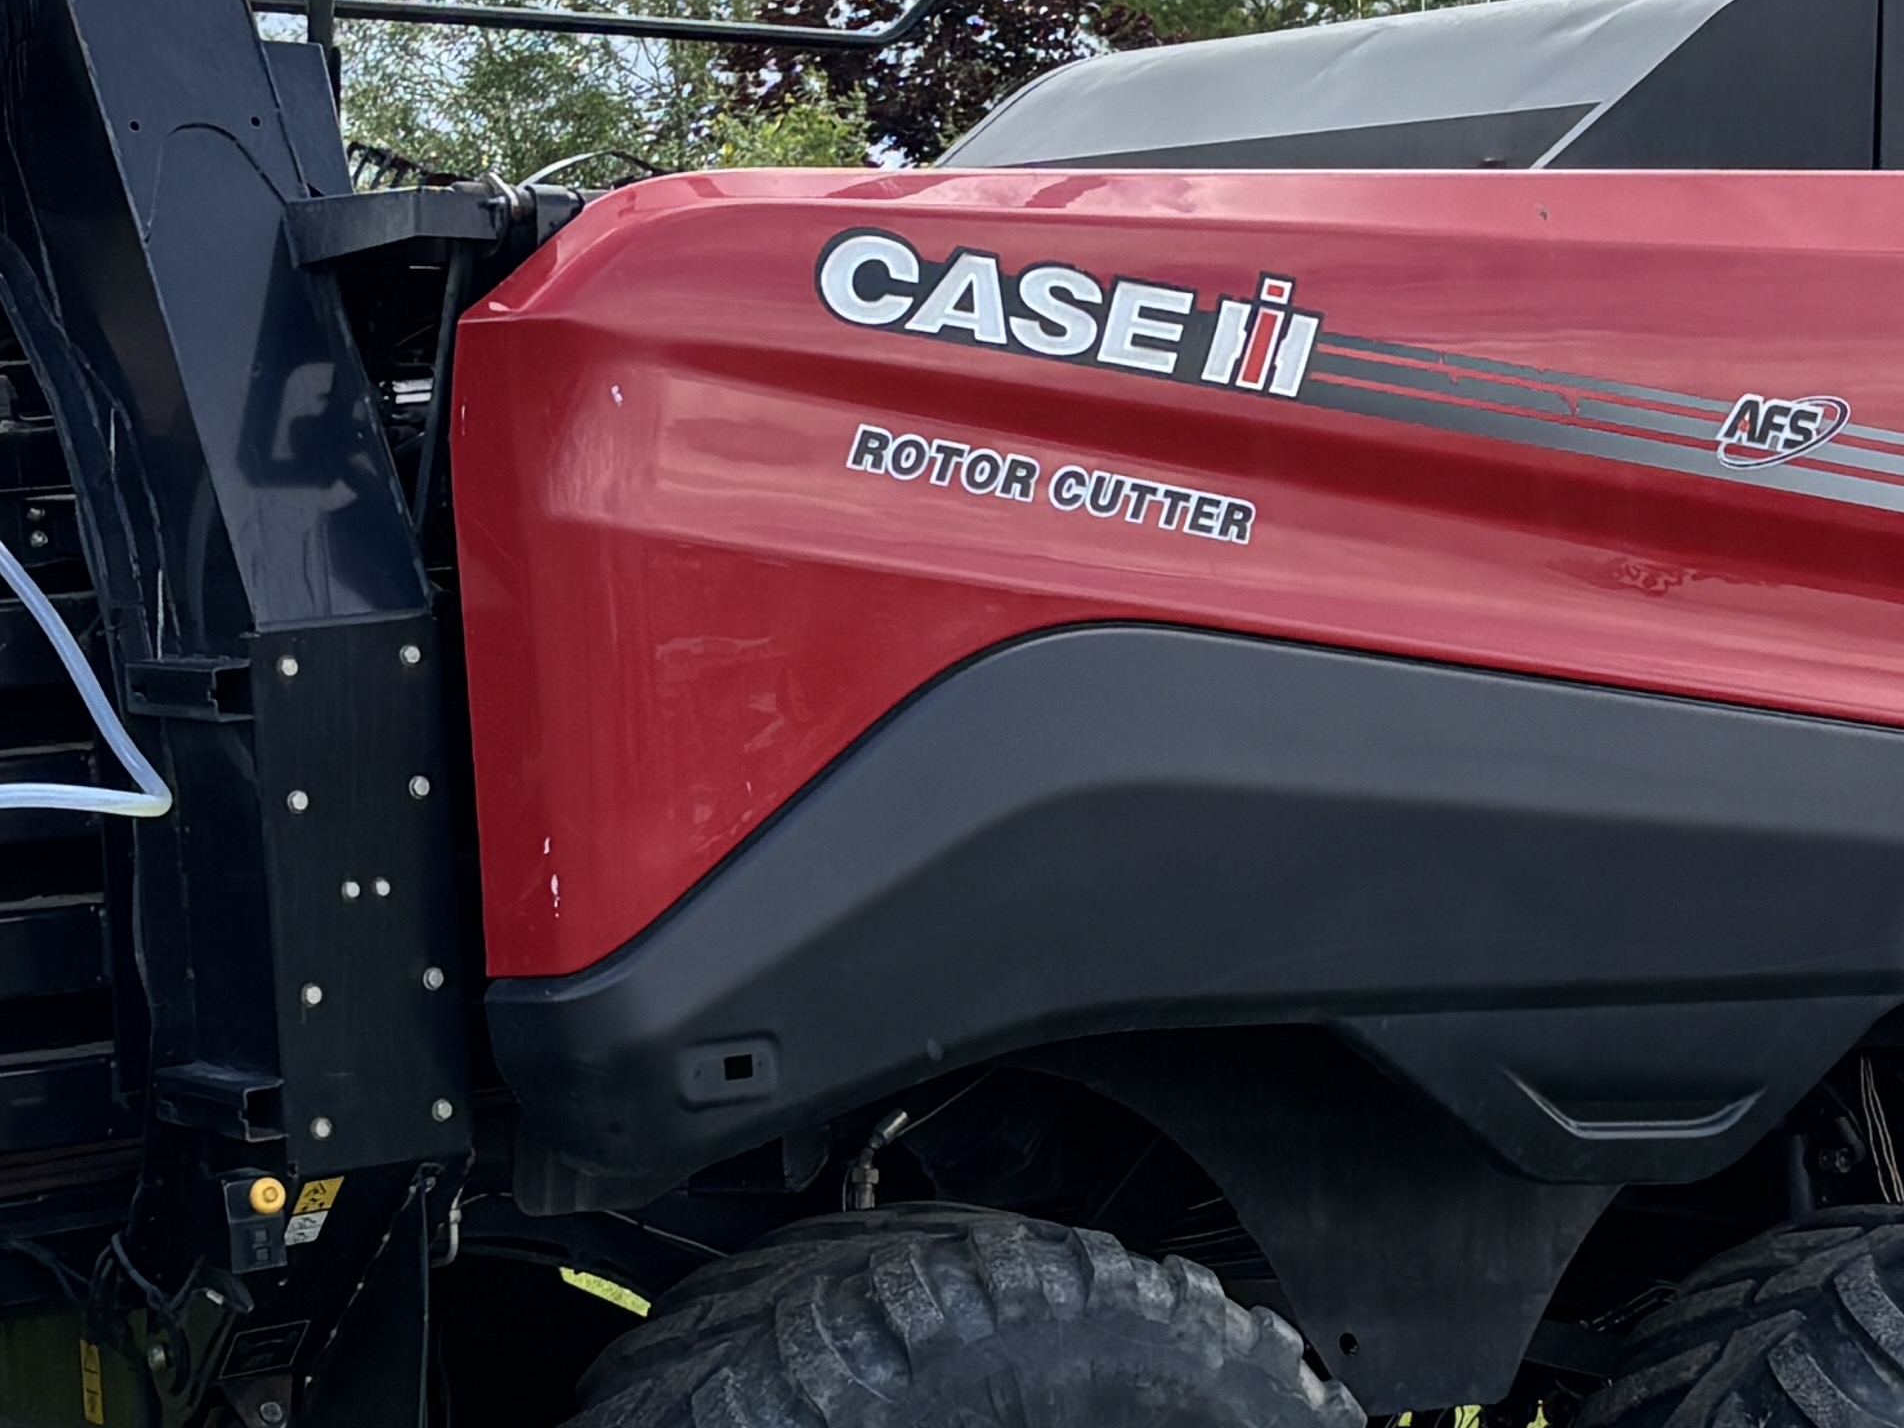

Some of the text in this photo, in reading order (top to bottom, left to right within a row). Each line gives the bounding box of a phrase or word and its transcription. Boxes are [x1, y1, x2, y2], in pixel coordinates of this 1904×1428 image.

[818, 232, 1195, 373] CASE
[846, 422, 1258, 546] ROTOR CUTTER
[1717, 392, 1824, 452] AFS
